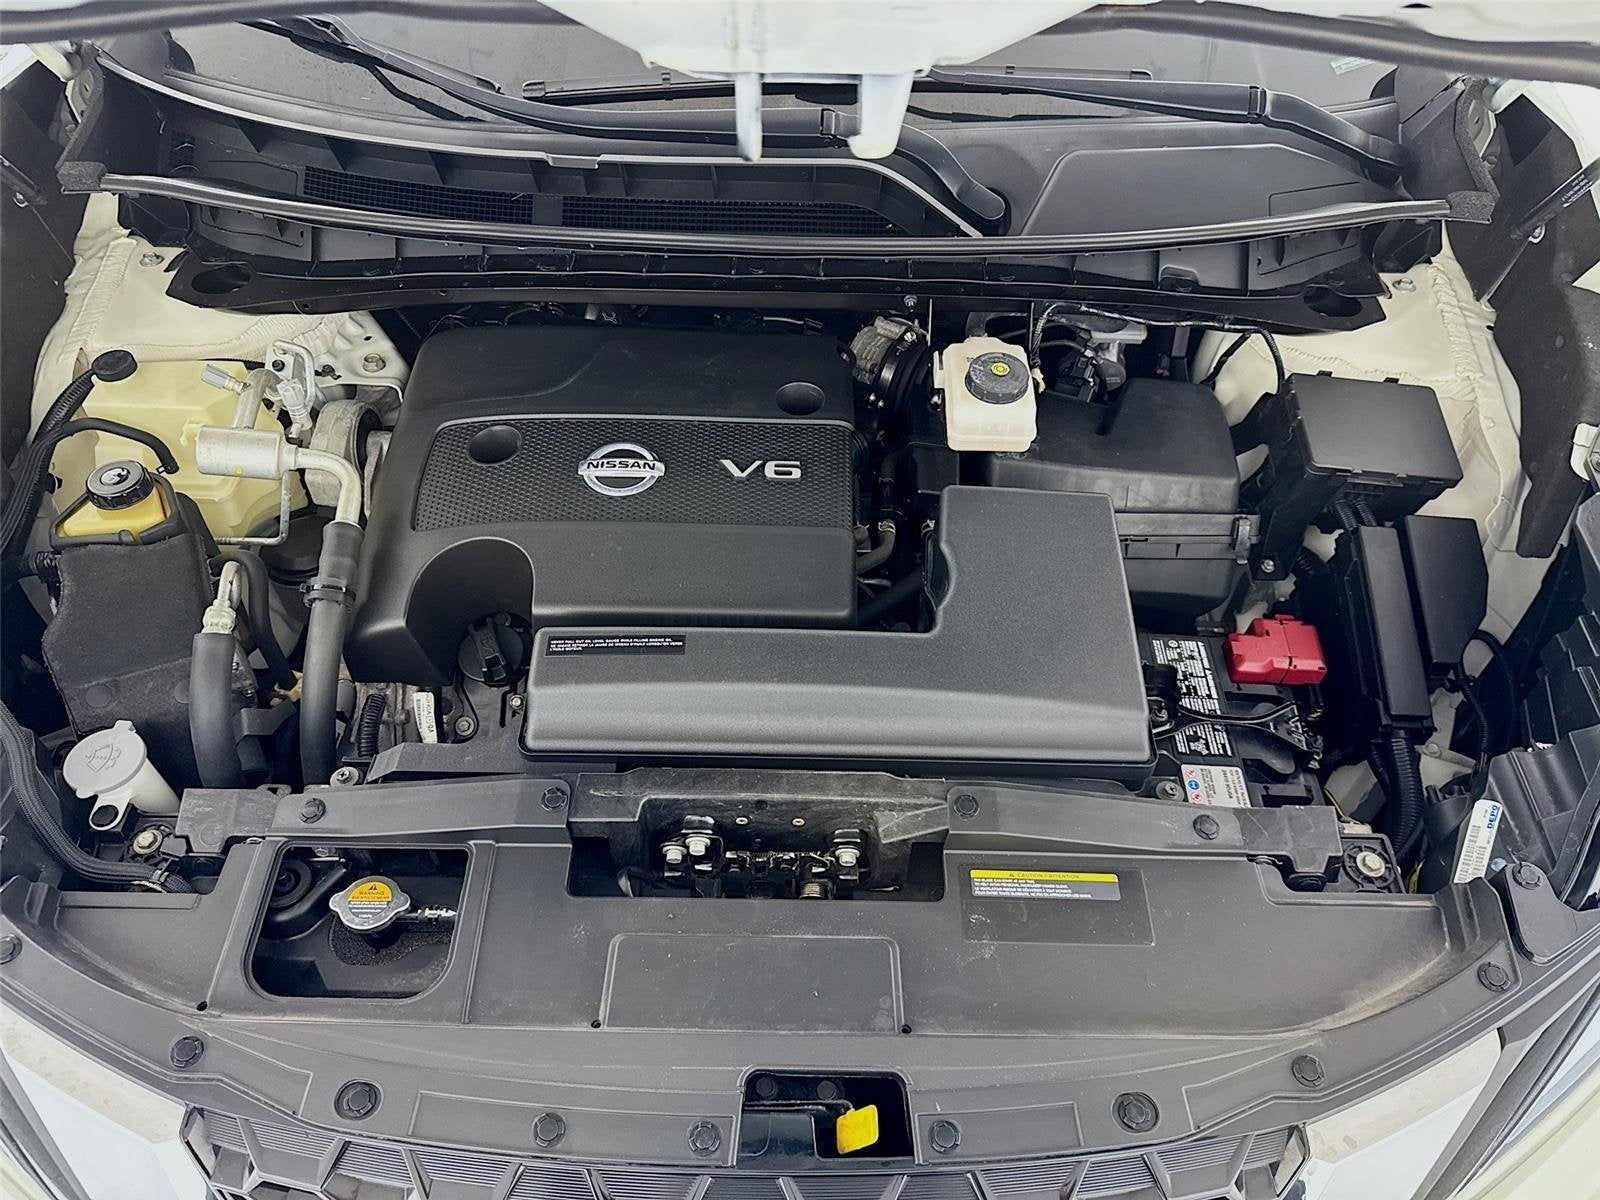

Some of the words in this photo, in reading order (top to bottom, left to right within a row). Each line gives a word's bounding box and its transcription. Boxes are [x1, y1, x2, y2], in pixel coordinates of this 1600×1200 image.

[587, 460, 656, 470] NISSAN
[720, 459, 802, 479] V6
[1487, 804, 1498, 829] DEPO
